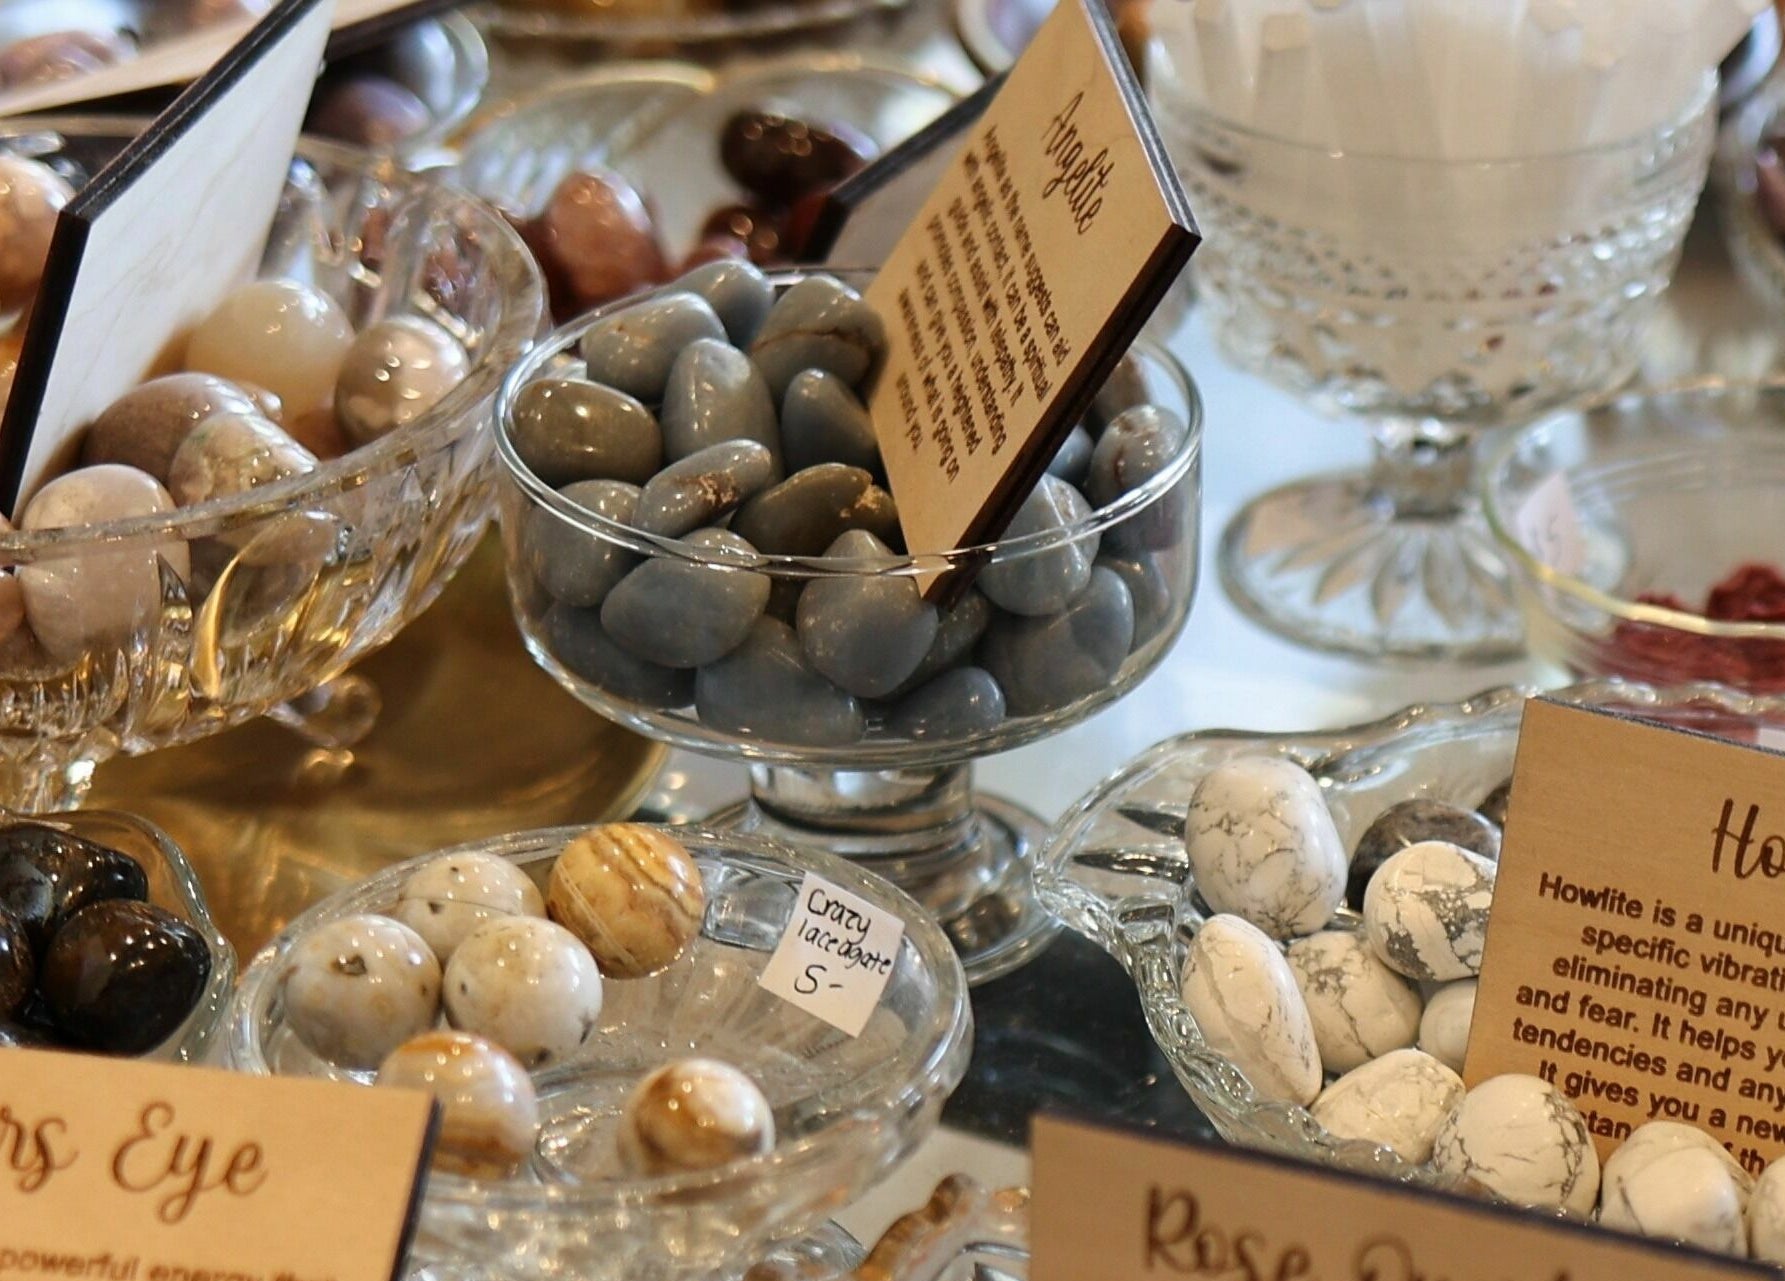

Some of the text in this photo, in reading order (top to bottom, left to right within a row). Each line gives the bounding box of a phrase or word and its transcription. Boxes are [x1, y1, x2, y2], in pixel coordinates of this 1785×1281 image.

[1040, 91, 1114, 236] Angelite
[807, 888, 872, 945] Crazy
[1539, 871, 1642, 918] Howlite
[1652, 899, 1676, 927] is
[1685, 913, 1703, 934] a
[1581, 925, 1690, 969] specific
[1516, 985, 1570, 1014] and
[1578, 993, 1638, 1032] fear.
[1651, 1011, 1670, 1040] It
[1679, 1018, 1755, 1060] helps
[1552, 954, 1707, 1017] eliminating
[1715, 996, 1769, 1031] any
[1512, 1017, 1666, 1076] tendencies
[1675, 1061, 1731, 1092] and
[1563, 1070, 1638, 1106] gives
[1646, 1092, 1699, 1122] you
[1708, 1108, 1726, 1128] a
[111, 1101, 268, 1226] Eye
